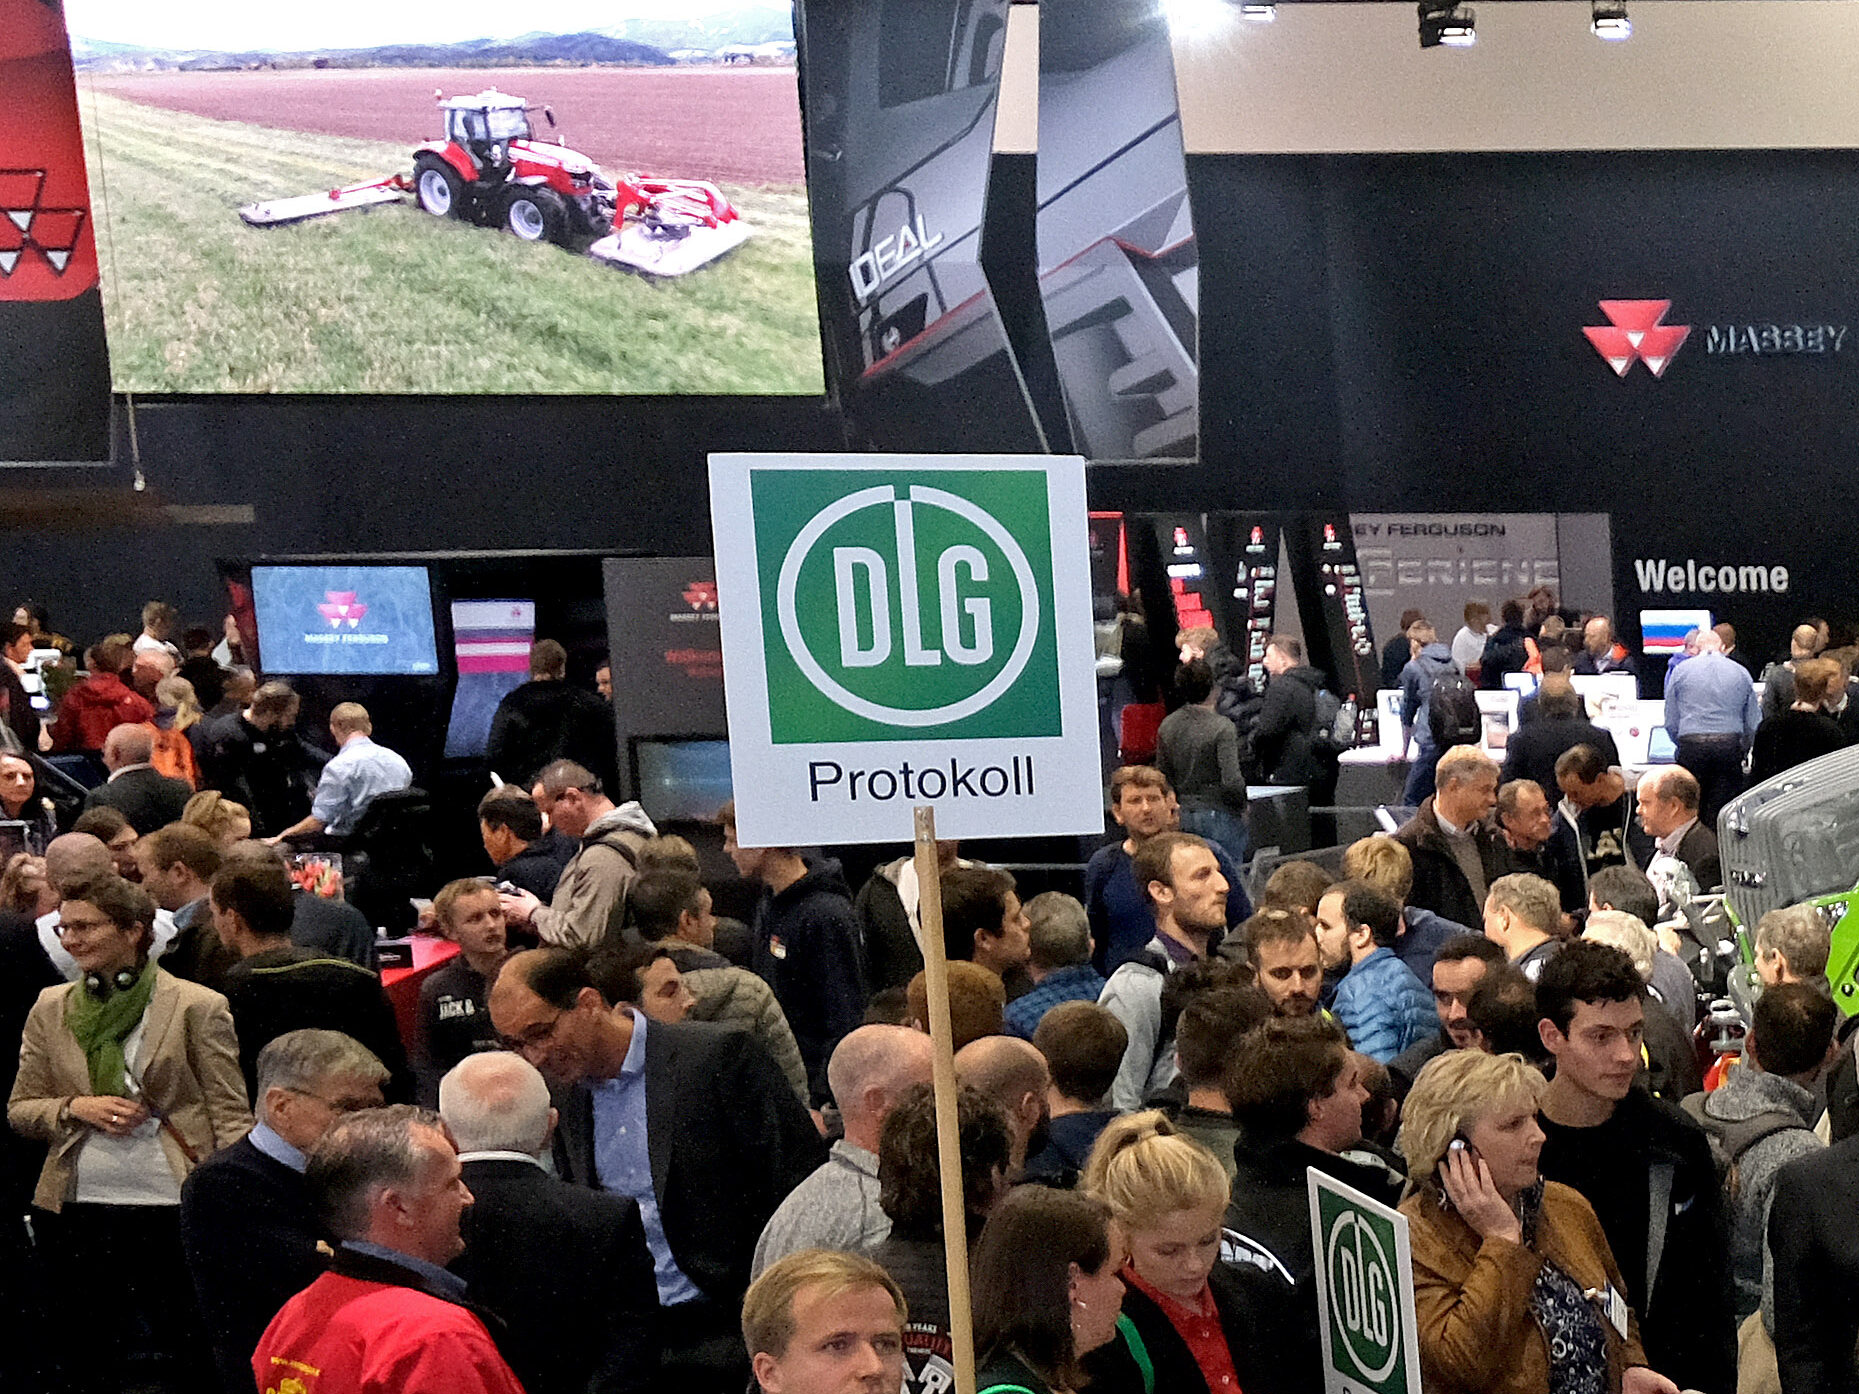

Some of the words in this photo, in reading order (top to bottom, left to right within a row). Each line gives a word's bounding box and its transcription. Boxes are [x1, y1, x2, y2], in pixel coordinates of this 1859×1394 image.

[1707, 325, 1846, 354] MASSEY
[1387, 522, 1506, 537] FERGUSON
[832, 499, 995, 668] DLG
[1635, 558, 1789, 594] Welcome
[808, 756, 1036, 802] Protokoll
[1340, 1221, 1388, 1348] DLG
